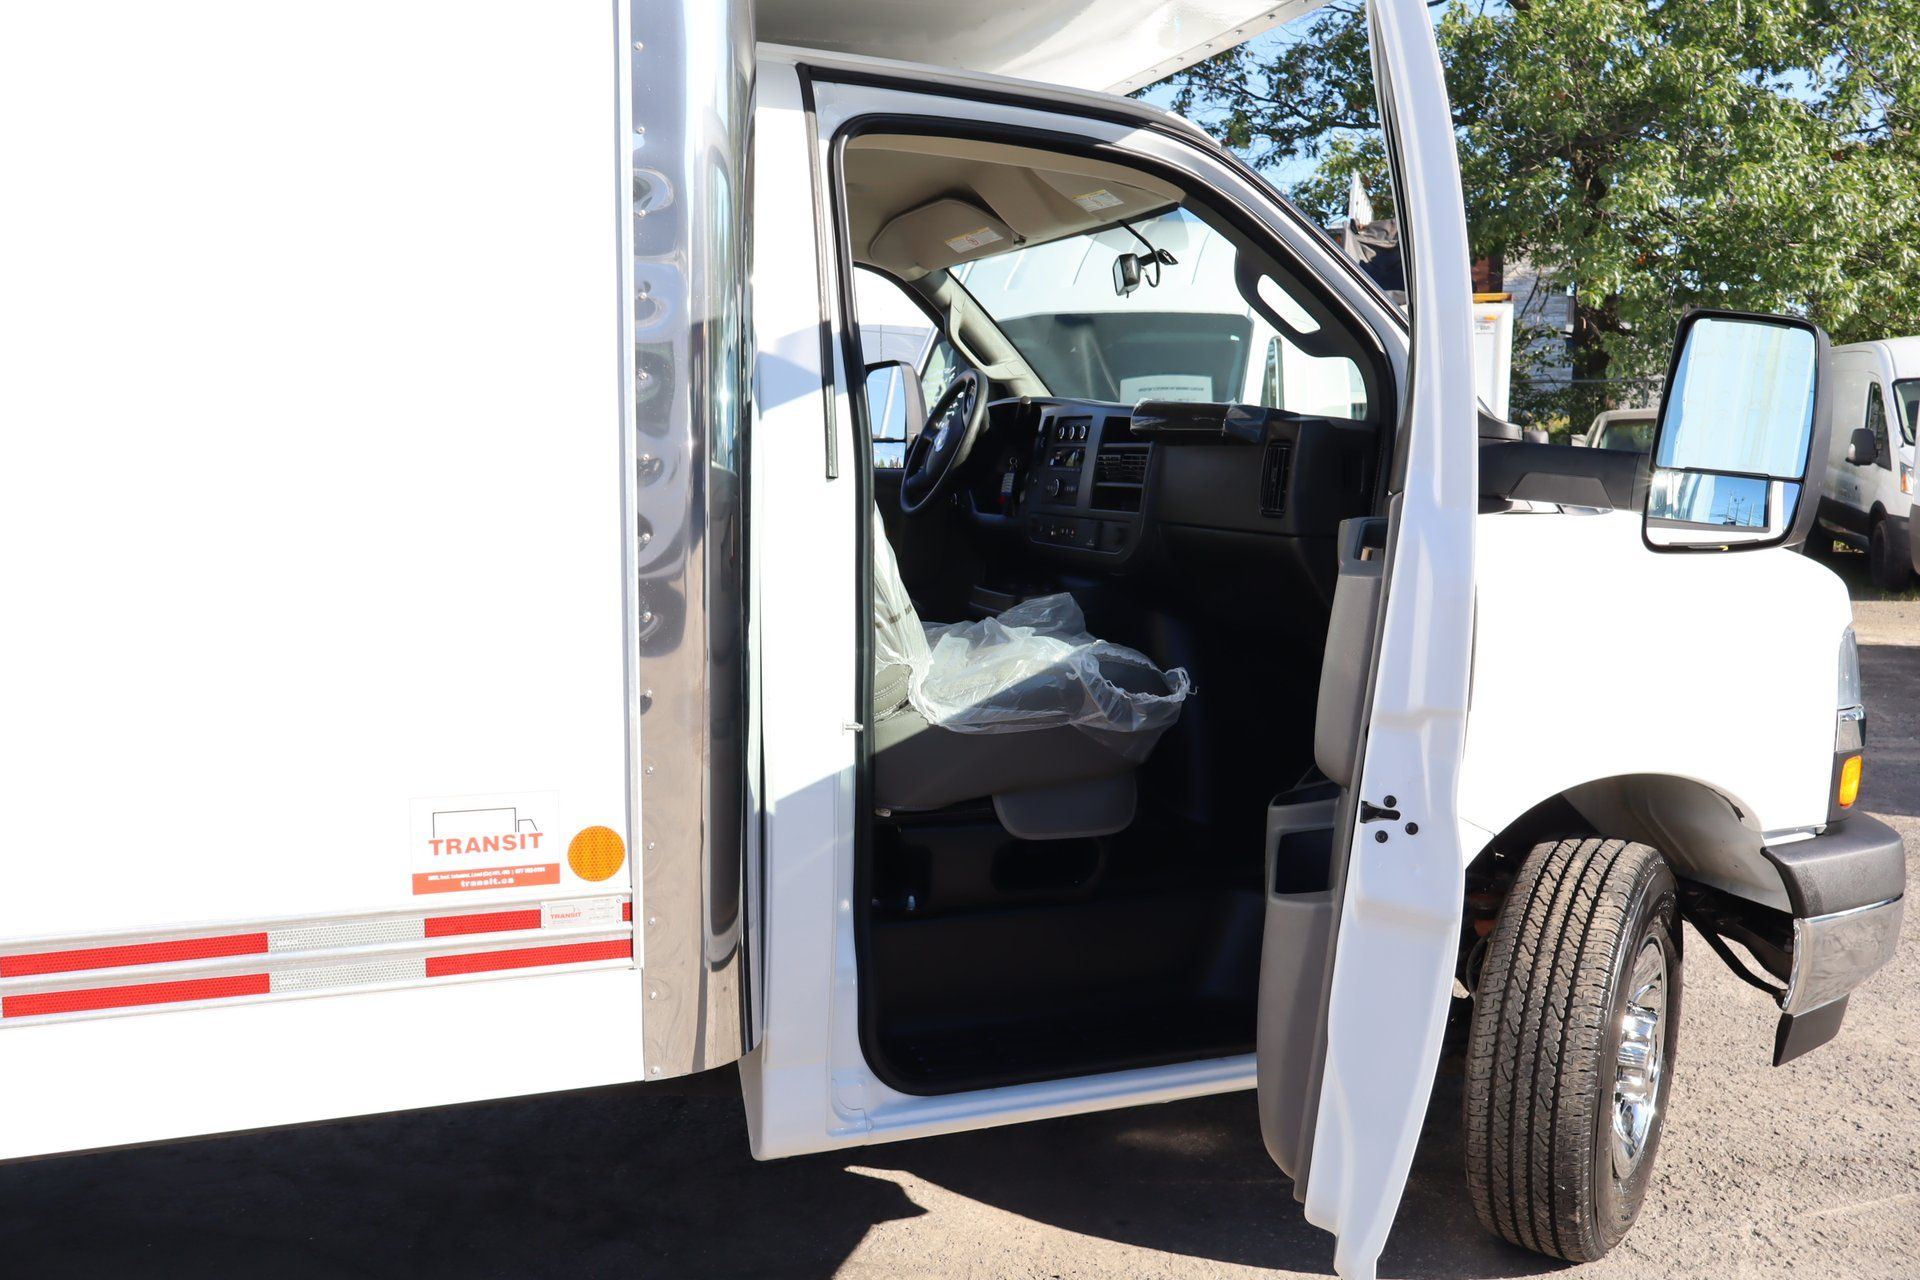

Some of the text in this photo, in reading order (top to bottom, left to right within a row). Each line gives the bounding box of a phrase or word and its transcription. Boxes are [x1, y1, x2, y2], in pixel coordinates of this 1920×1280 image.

[429, 832, 543, 856] TRANSIT
[461, 876, 515, 888] transit.ca
[550, 912, 582, 920] TRANSIT
